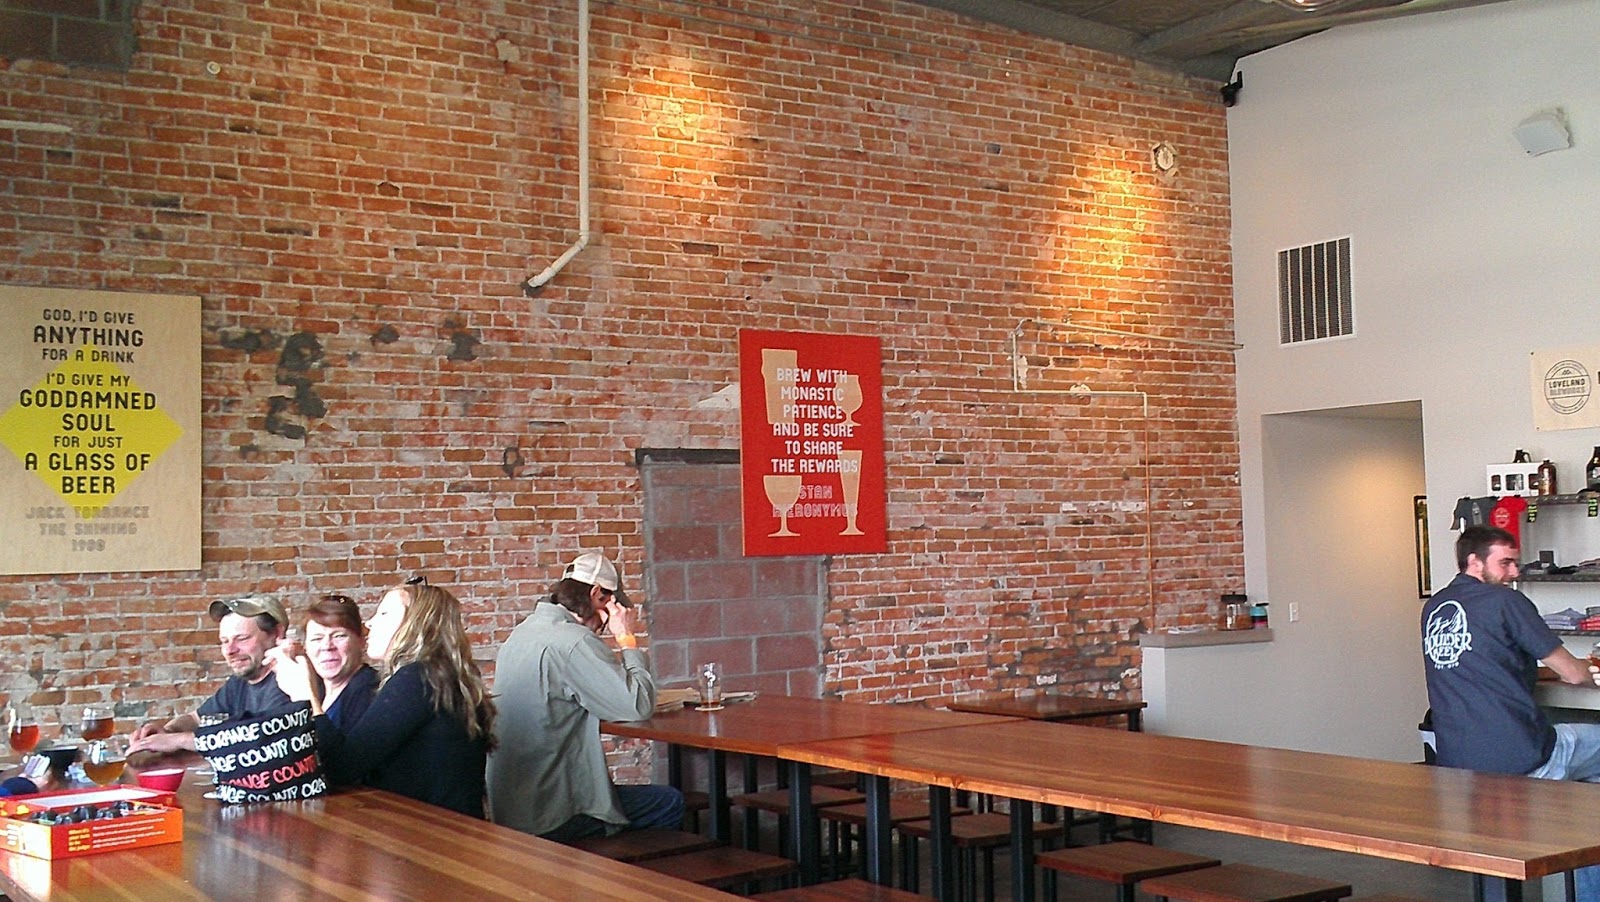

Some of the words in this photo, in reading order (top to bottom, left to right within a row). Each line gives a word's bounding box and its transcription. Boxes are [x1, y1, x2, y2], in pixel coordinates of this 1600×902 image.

[43, 309, 76, 323] GOD,
[79, 311, 97, 322] I'D
[104, 312, 135, 325] GIVE
[34, 325, 143, 347] ANYTHING
[42, 348, 67, 361] FOR
[75, 350, 84, 362] A
[91, 351, 134, 363] DRINK
[46, 373, 65, 385] I'D
[71, 374, 103, 385] GIVE
[110, 375, 130, 387] MY
[776, 368, 811, 383] BREW
[816, 369, 848, 383] WITH
[1549, 378, 1585, 389] LOVELAND
[20, 389, 156, 410] GODDAMNED
[781, 387, 844, 401] MONASTIC
[783, 405, 843, 419] PATIENCE
[62, 414, 115, 431] SOUL
[773, 422, 799, 436] AND
[804, 423, 818, 437] BE
[823, 424, 854, 437] SURE
[54, 436, 80, 448] FOR
[88, 436, 123, 448] JUST
[785, 440, 800, 455] TO
[804, 441, 843, 455] SHARE
[25, 452, 37, 470] A
[49, 453, 115, 471] GLASS
[126, 454, 150, 471] OF
[771, 458, 795, 473] THE
[799, 459, 858, 473] REWARDS
[62, 476, 115, 494] BEER
[799, 485, 832, 499] STAN
[25, 506, 65, 519] JACK
[40, 522, 66, 535] THE
[74, 522, 137, 535] SHINING
[261, 708, 309, 736] COUNTY
[238, 739, 288, 767] COUNTY
